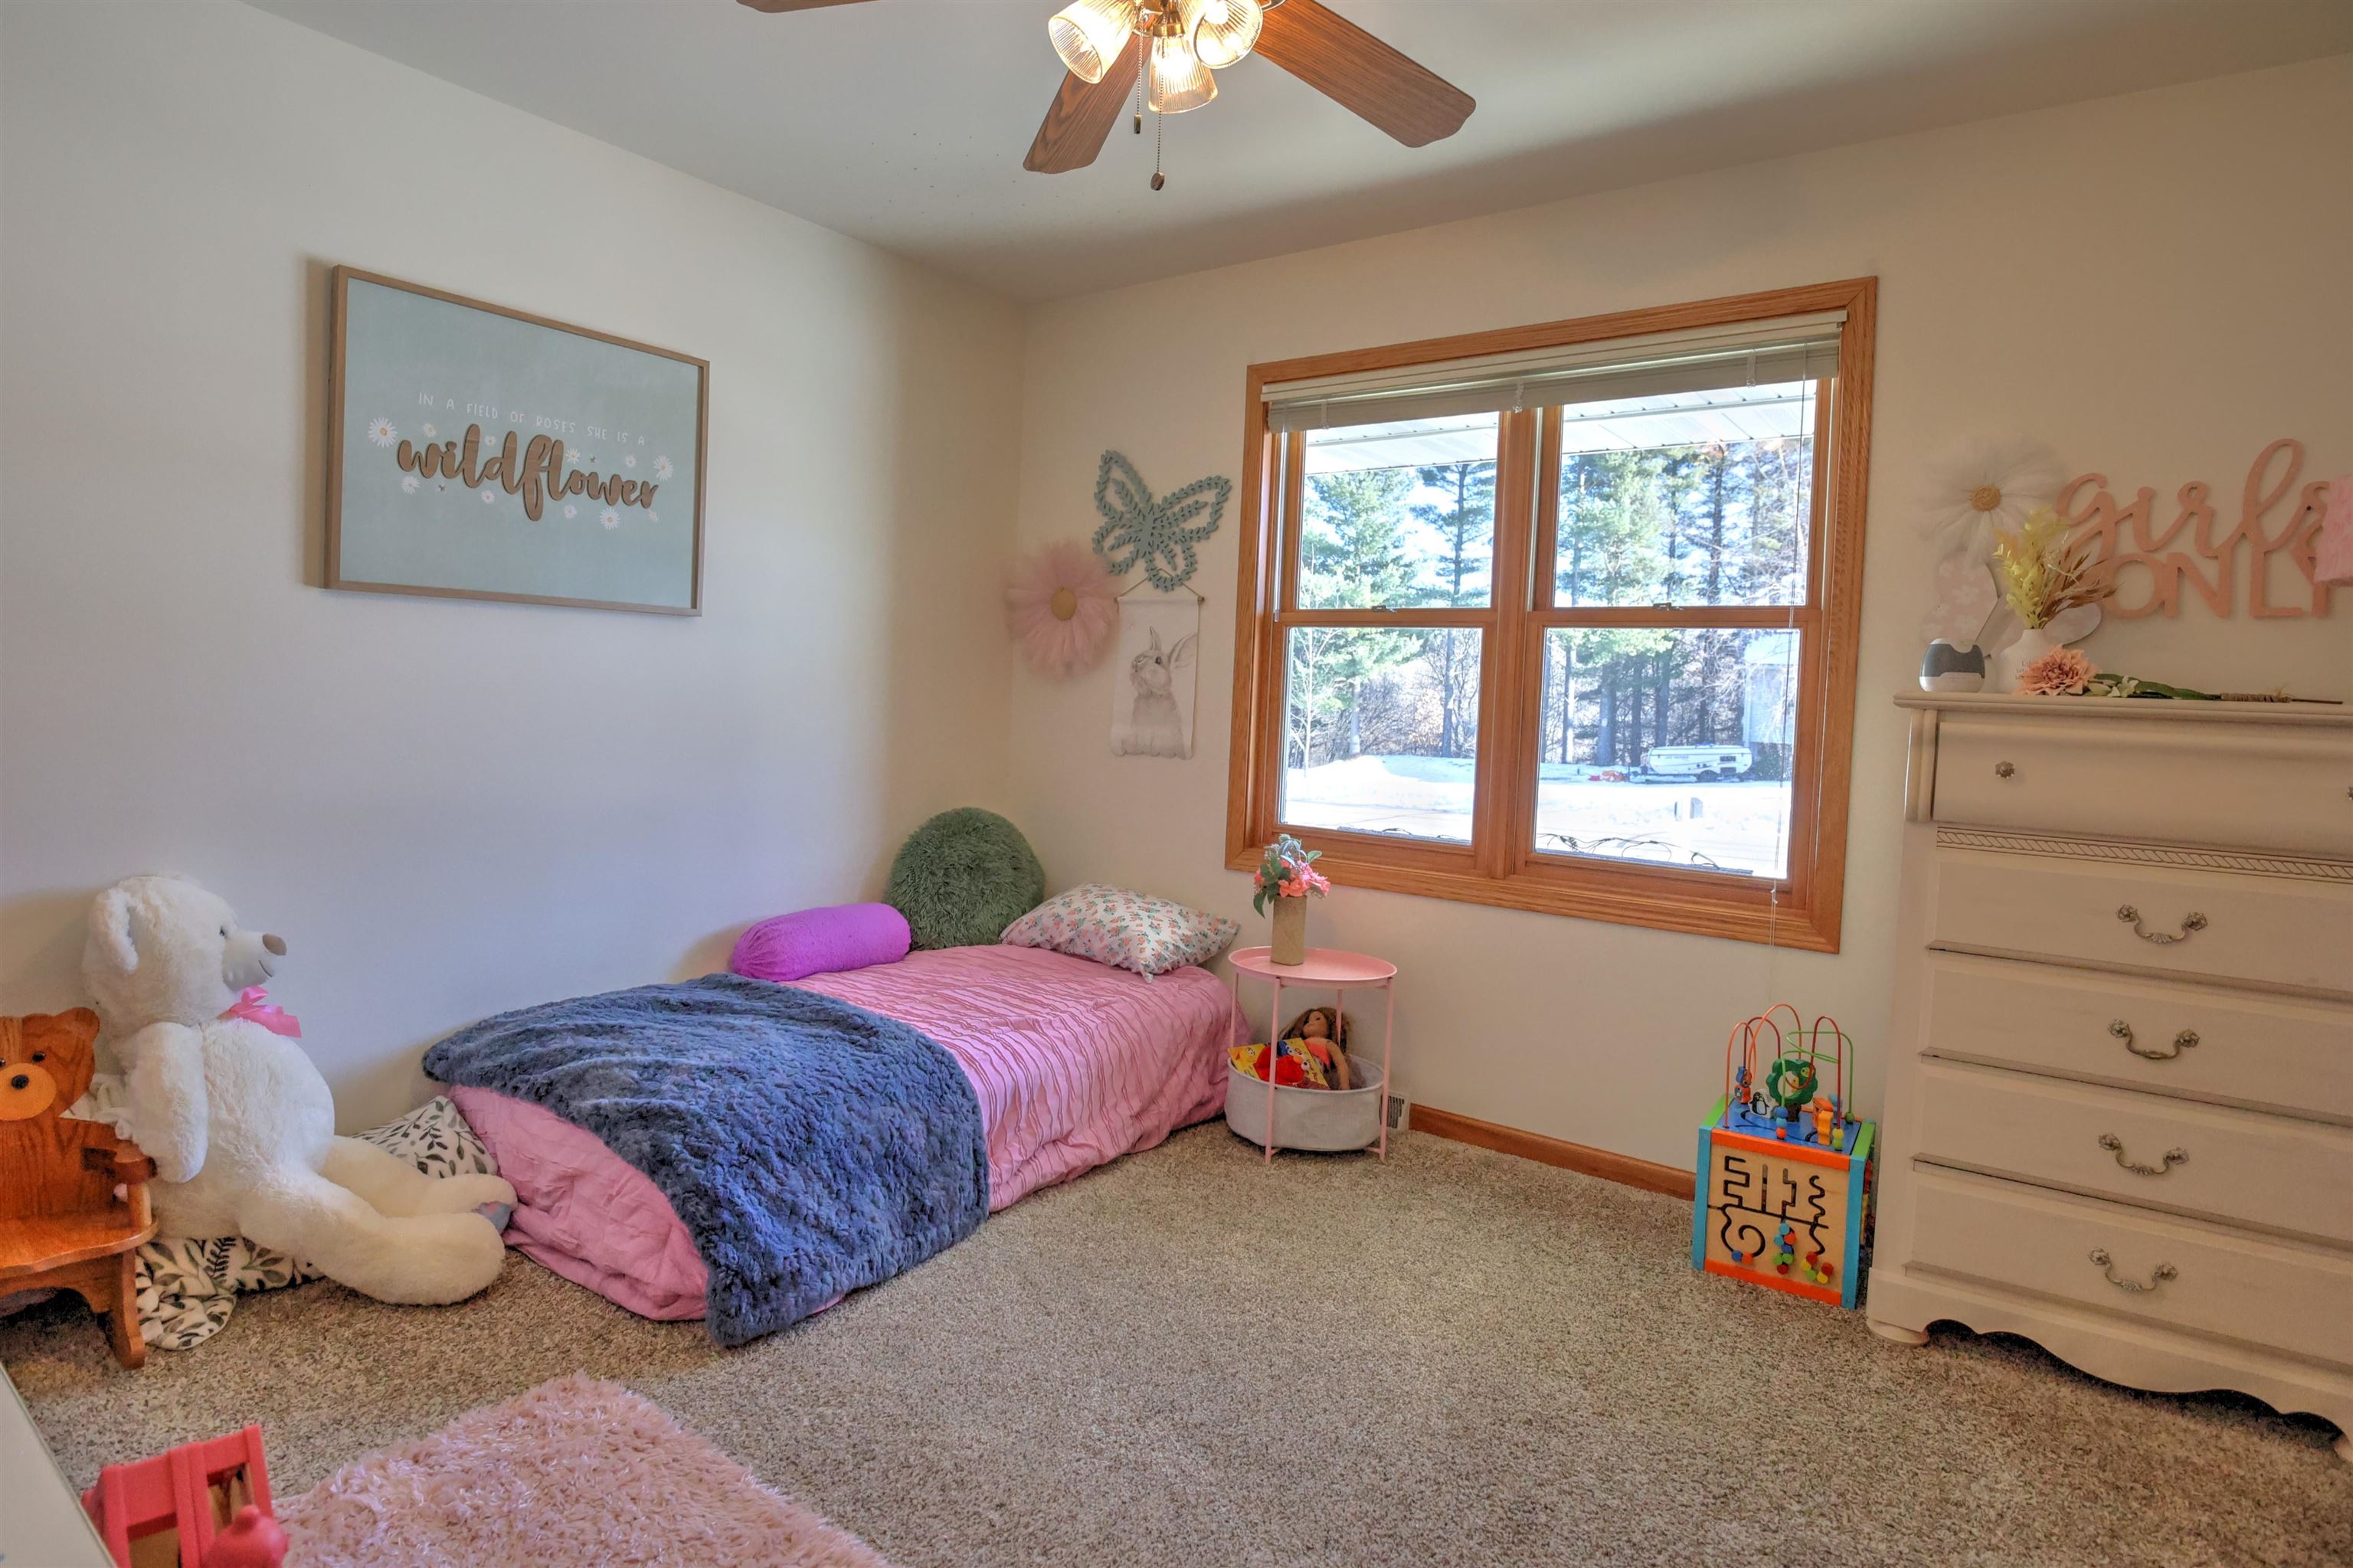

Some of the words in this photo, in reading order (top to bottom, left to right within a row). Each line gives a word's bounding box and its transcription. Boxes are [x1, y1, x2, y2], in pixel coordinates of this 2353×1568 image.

[418, 392, 434, 406] IN
[447, 398, 454, 410] A
[466, 403, 498, 419] FIELD
[510, 411, 525, 424] OF
[536, 415, 575, 434] ROSES
[587, 425, 607, 440] SHE
[617, 431, 628, 443] IS
[637, 435, 645, 447] A
[398, 423, 659, 521] wildflower
